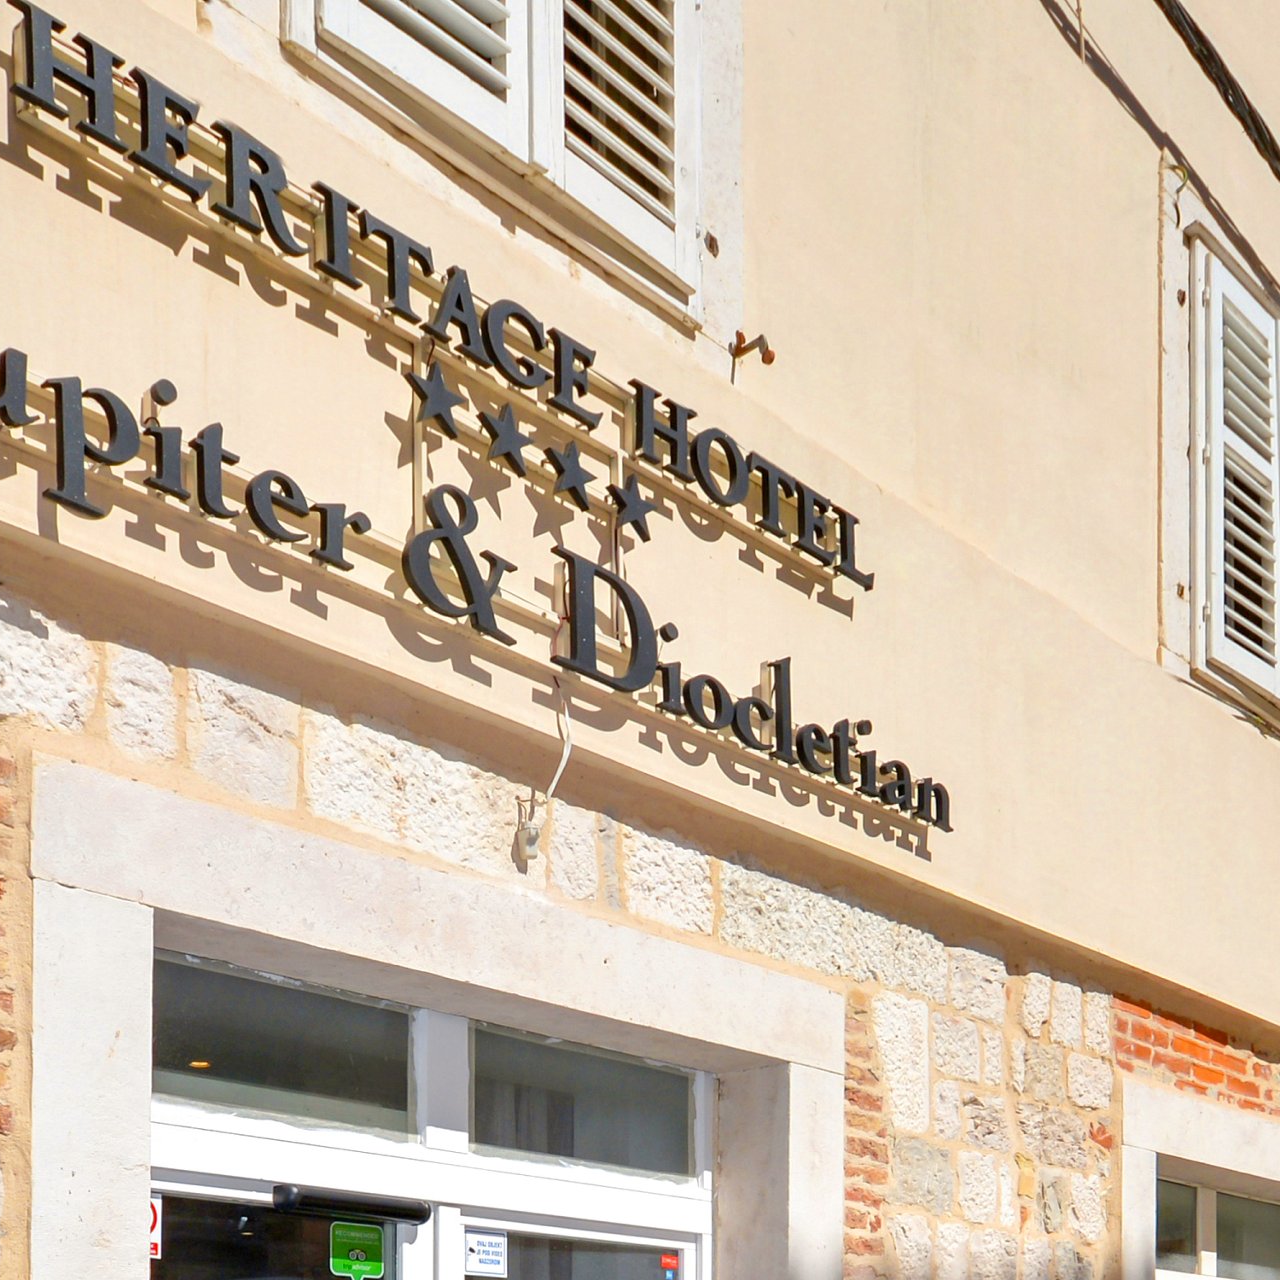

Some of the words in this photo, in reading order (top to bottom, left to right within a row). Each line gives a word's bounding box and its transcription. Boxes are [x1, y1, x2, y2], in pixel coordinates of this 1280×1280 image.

[7, 0, 603, 430] HERITAGE
[627, 378, 875, 592] HOTEL
[401, 483, 518, 646] &
[551, 544, 953, 833] Diocletian
